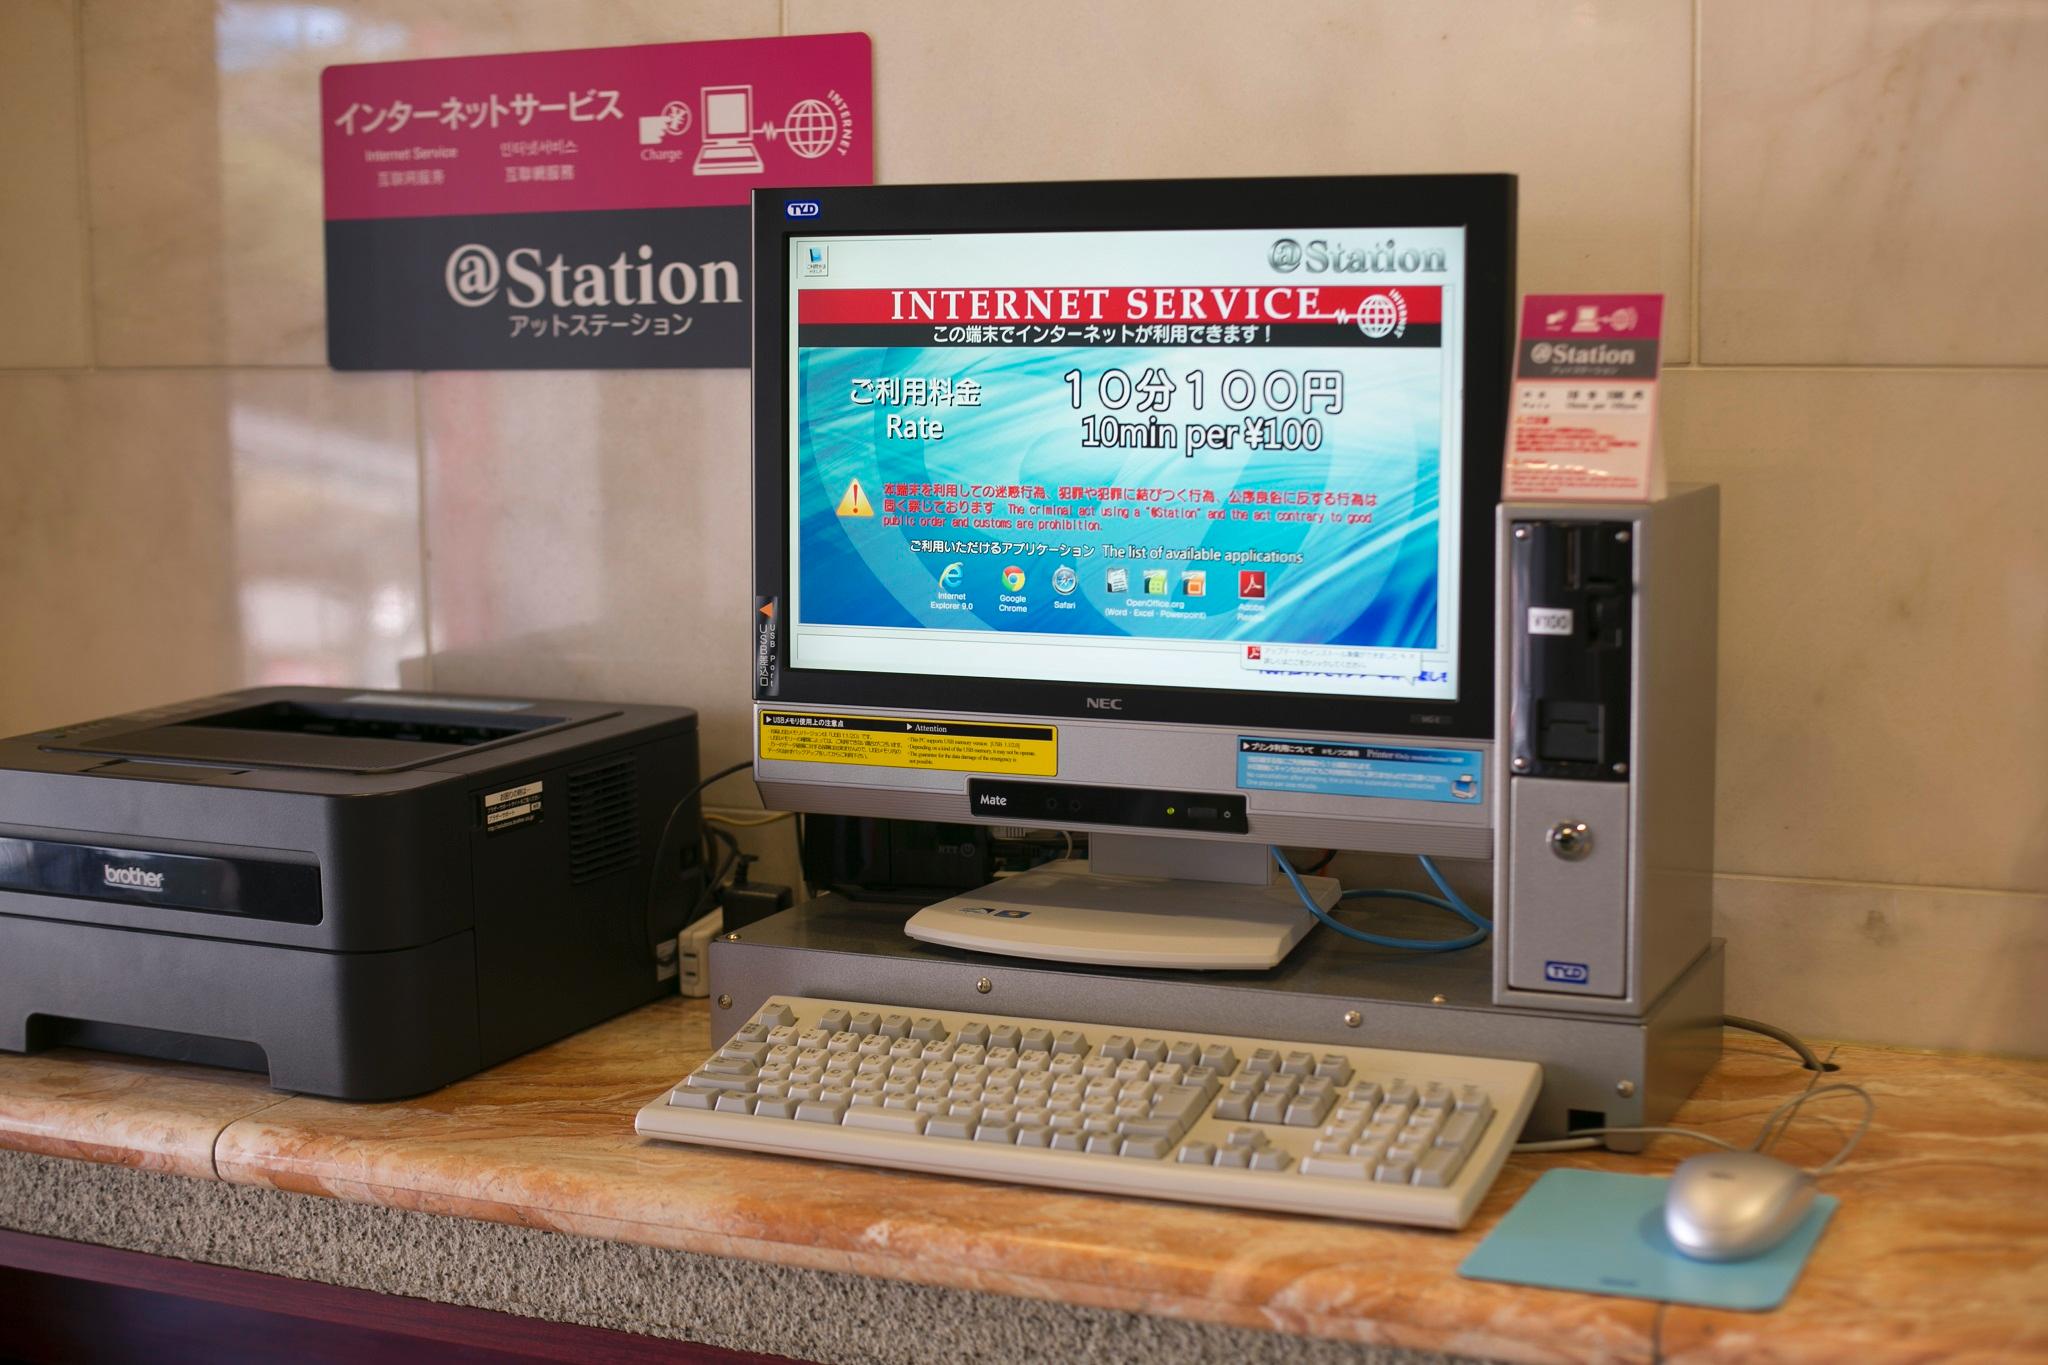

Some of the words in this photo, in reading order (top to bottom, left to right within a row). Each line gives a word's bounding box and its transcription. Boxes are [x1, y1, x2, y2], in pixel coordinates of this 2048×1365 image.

[334, 88, 624, 136] インターネットサービス
[827, 89, 853, 157] INTERNET
[365, 147, 411, 163] Internet
[412, 145, 459, 160] Service
[640, 148, 683, 163] Charge
[1267, 238, 1448, 274] @Station
[444, 243, 743, 309] @Station
[890, 288, 1110, 320] INTERNET
[1126, 286, 1321, 320] SERVICE
[508, 312, 693, 338] アットステーション
[933, 324, 1272, 344] この端末でインターネットが利用できます！
[1531, 341, 1635, 365] @Station
[850, 376, 983, 407] ご利用料金
[1063, 368, 1344, 415] 10分100円
[886, 413, 945, 440] Rate
[1081, 414, 1178, 448] 10min
[1185, 422, 1239, 457] per
[1244, 416, 1323, 451] ¥100
[883, 515, 916, 528] public
[919, 516, 946, 527] order
[951, 517, 969, 527] and
[974, 518, 1012, 528] customs
[1016, 519, 1034, 529] are
[1038, 518, 1103, 531] prohibition.
[1008, 504, 1025, 515] The
[1030, 505, 1073, 516] criminal
[1079, 506, 1096, 517] act
[1101, 507, 1129, 519] using
[1134, 508, 1141, 518] a
[1208, 509, 1226, 520] and
[1231, 509, 1249, 520] the
[1254, 510, 1271, 521] act
[1276, 511, 1324, 524] contrary
[1331, 512, 1342, 522] to
[1347, 513, 1373, 524] good
[909, 539, 1095, 557] ご利用いただけるアプリケーション
[1102, 543, 1126, 558] The
[1128, 545, 1147, 559] list
[1149, 546, 1164, 560] of
[1165, 547, 1221, 561] available
[1224, 549, 1304, 564] applications
[930, 601, 960, 611] Explorer
[961, 602, 974, 610] 9.0
[938, 591, 966, 601] Internet
[999, 595, 1027, 604] Google
[1053, 601, 1076, 609] Safari
[998, 604, 1028, 613] Chrome
[1086, 697, 1123, 710] NEC
[914, 724, 947, 733] Attention
[1366, 749, 1394, 759] Printer
[980, 794, 1007, 806] Mate
[104, 864, 165, 888] brother
